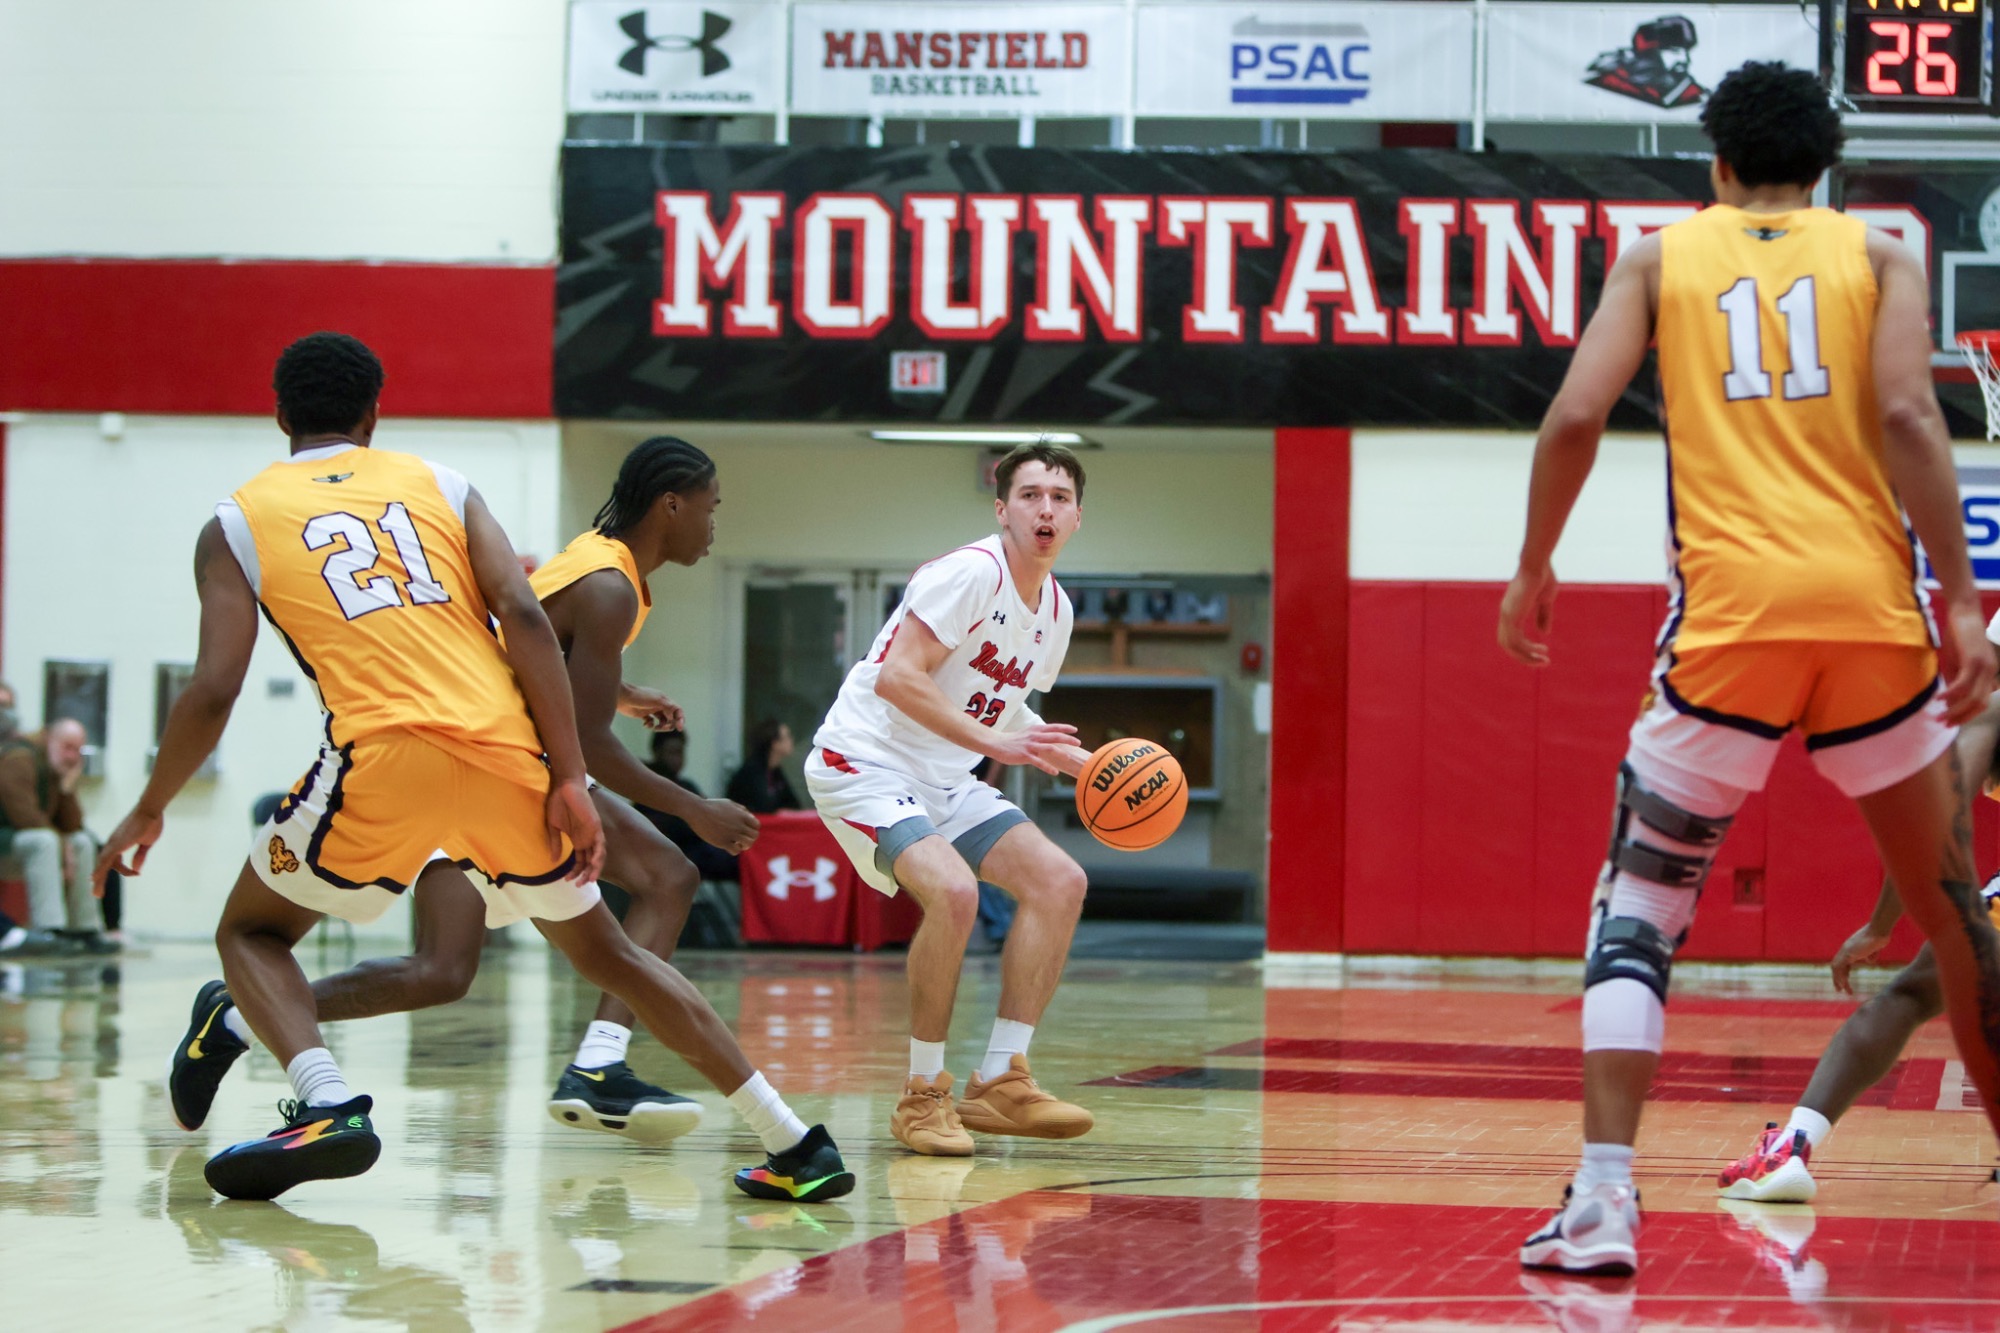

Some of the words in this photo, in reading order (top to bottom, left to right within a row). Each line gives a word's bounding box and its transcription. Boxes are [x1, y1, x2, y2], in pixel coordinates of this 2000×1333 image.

[823, 31, 1088, 69] MANSFIELD
[1231, 43, 1371, 82] PSAC
[1867, 21, 1957, 95] 26
[871, 74, 1040, 97] BASKETBALL
[1717, 275, 1831, 401] 11
[301, 501, 452, 620] 21
[1092, 744, 1157, 793] Wilson
[1124, 769, 1170, 812] NCAA
